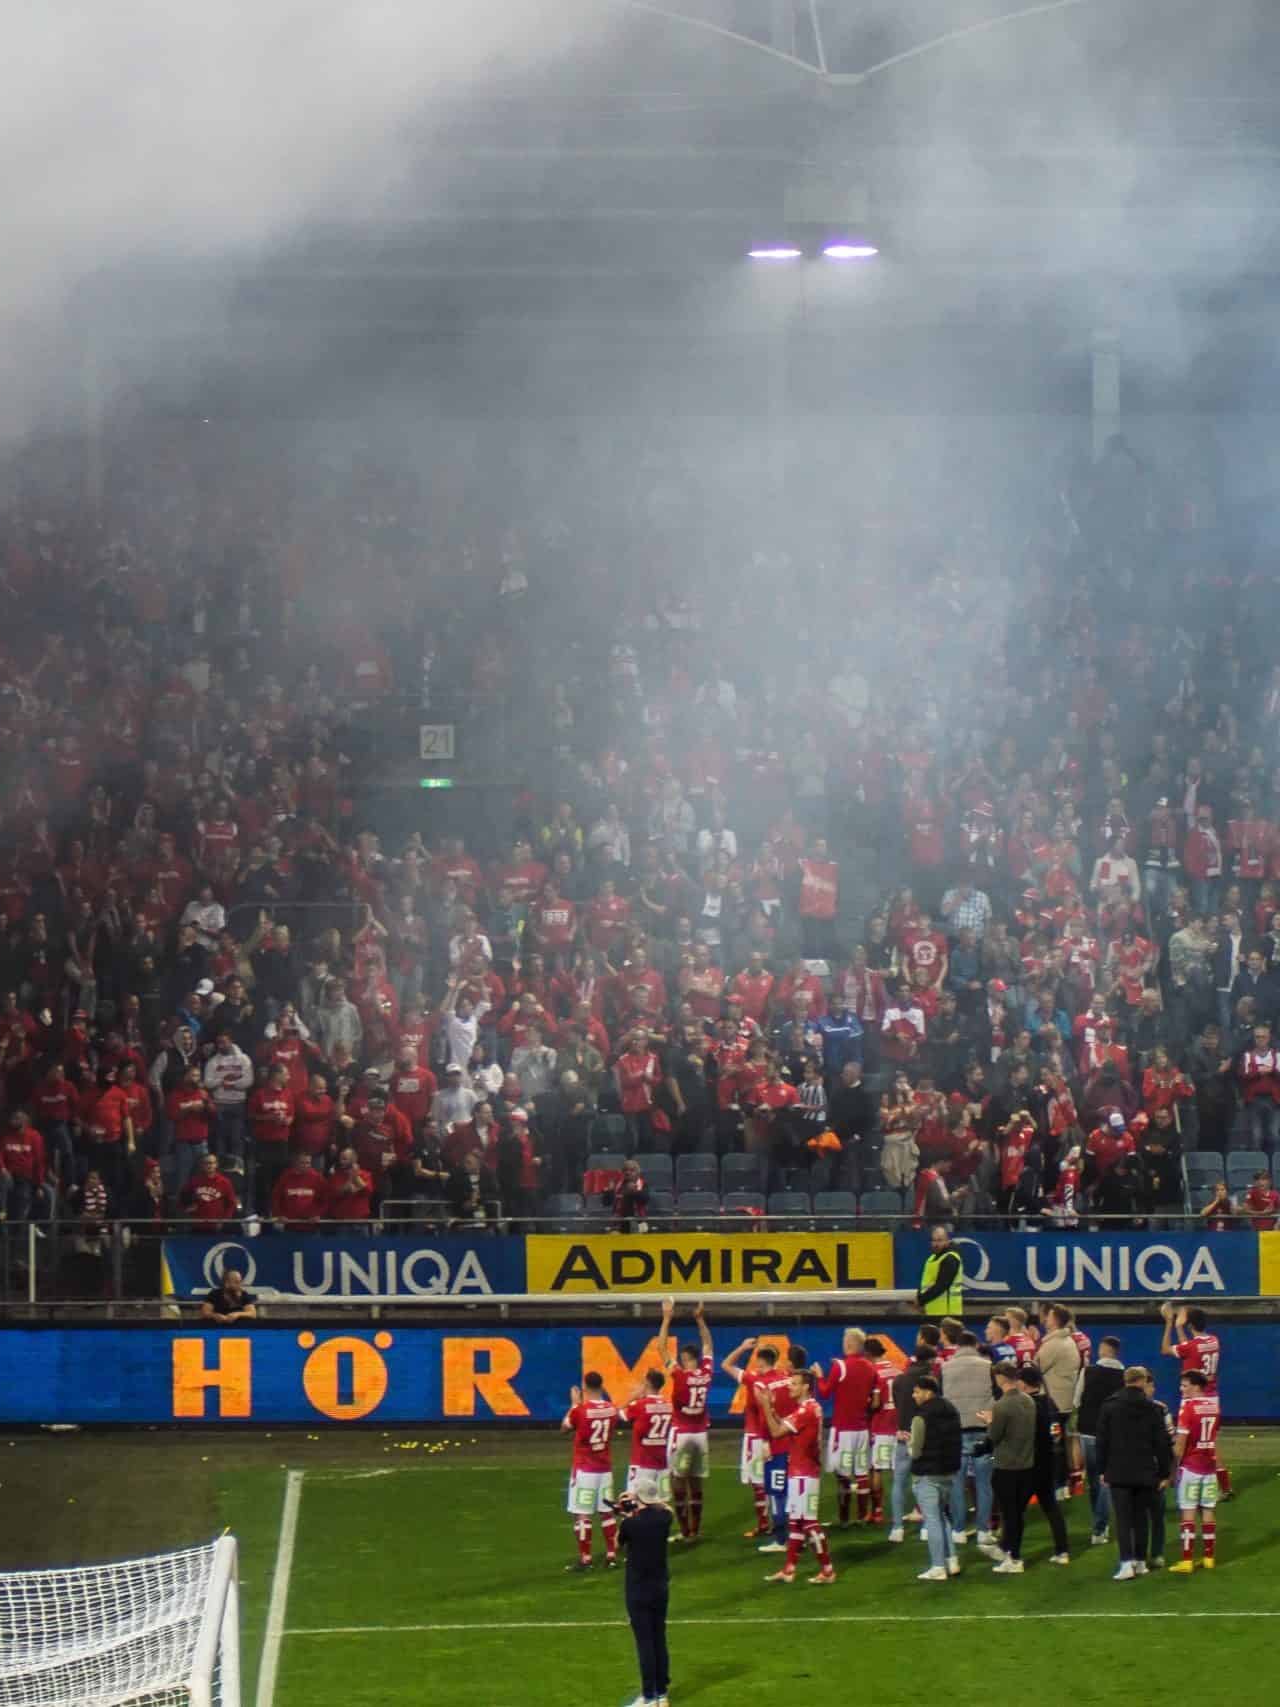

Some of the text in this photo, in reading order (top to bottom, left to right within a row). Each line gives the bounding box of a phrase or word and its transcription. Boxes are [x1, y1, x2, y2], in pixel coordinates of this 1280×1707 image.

[292, 1247, 493, 1297] UNIQA
[551, 1243, 877, 1291] ADMIRAL
[1026, 1244, 1226, 1293] UNIQA
[1201, 1352, 1219, 1376] 30
[688, 1386, 708, 1408] 13
[589, 1418, 611, 1444] 21
[647, 1414, 672, 1439] 27
[1200, 1416, 1217, 1442] 17
